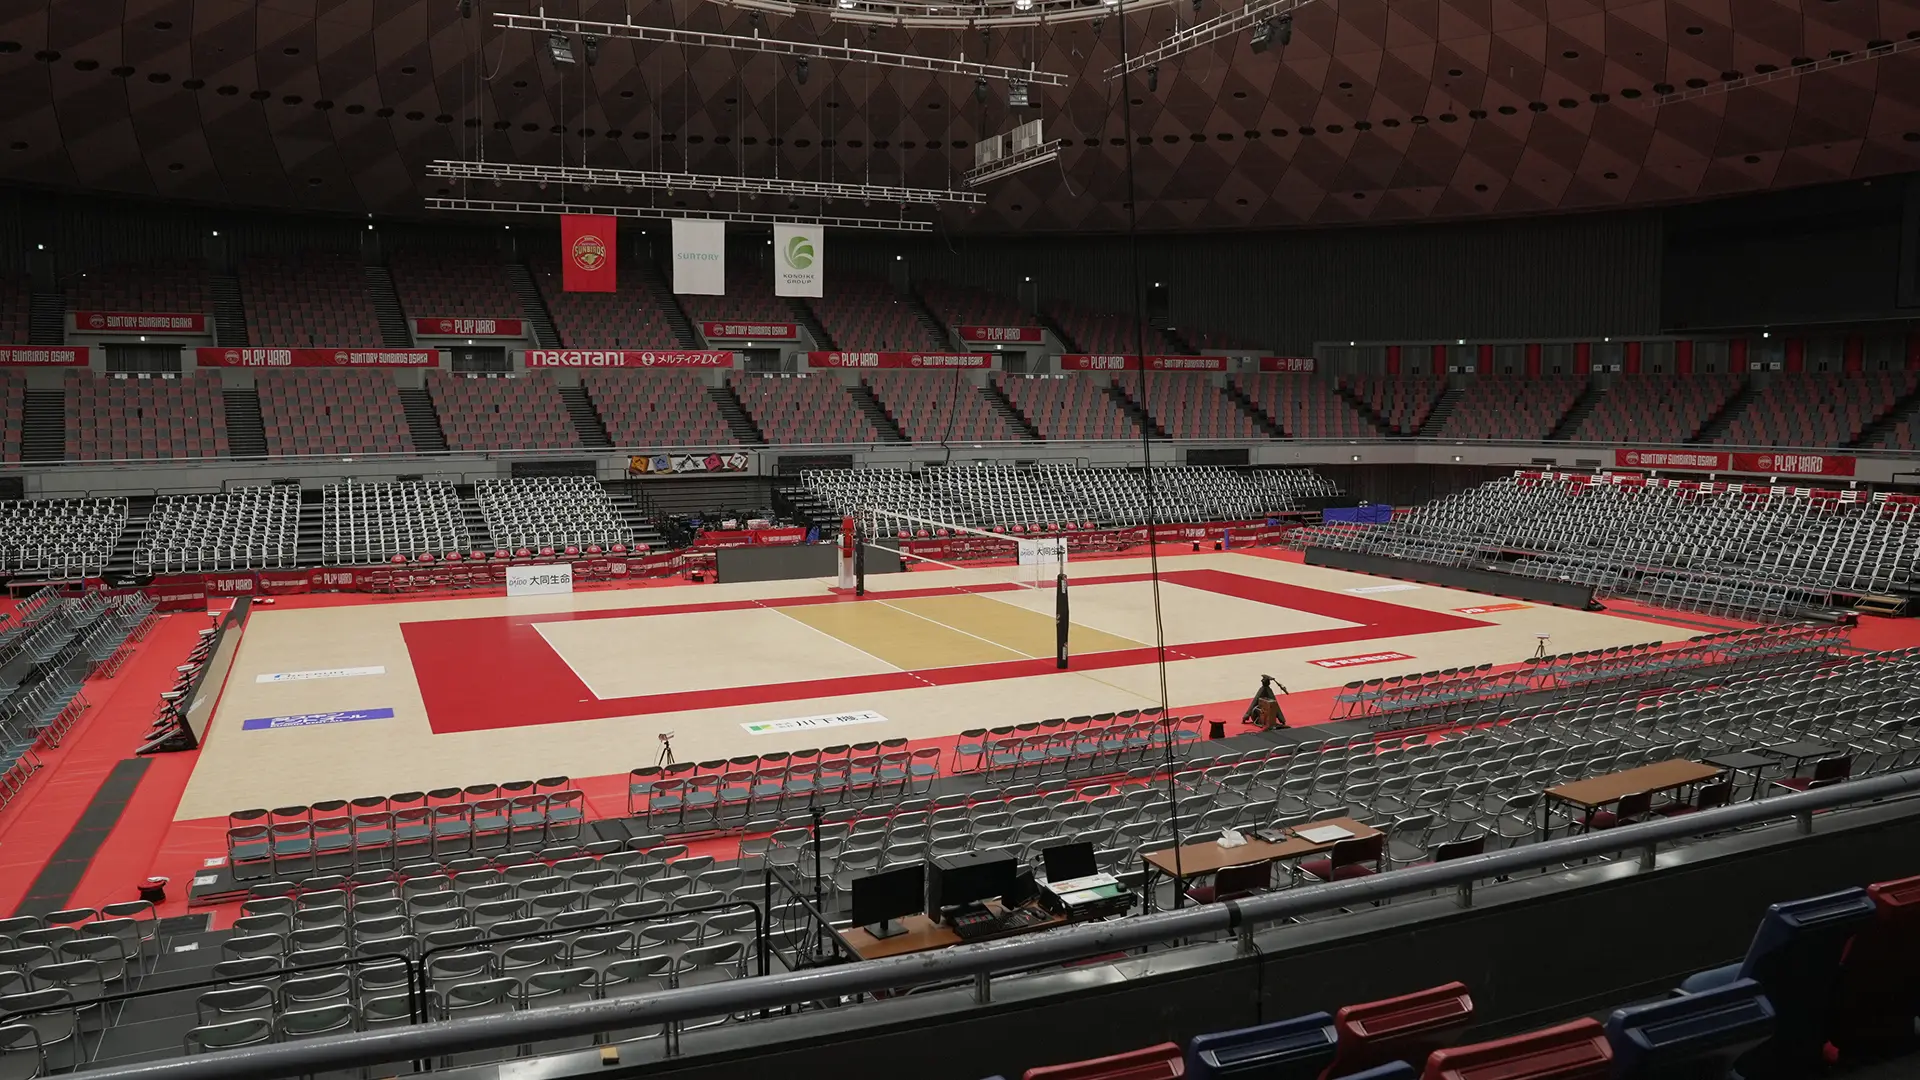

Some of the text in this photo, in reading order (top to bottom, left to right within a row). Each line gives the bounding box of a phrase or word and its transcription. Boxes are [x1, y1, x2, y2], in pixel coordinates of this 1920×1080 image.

[575, 245, 605, 257] SUNBIRDS
[677, 252, 719, 261] SUNTORY
[107, 316, 193, 328] SUNTORY SUNBIRDS OSAKA
[455, 319, 496, 333] PLAY HARD
[987, 328, 1021, 341] PLAY HARD
[12, 351, 49, 362] SUNBIRDS
[51, 351, 75, 362] OSAKA
[242, 349, 292, 366] PLAY HARD
[350, 352, 428, 364] SUNTORY SUNBIRDS OSAKA
[841, 353, 879, 366] PLAY HARD
[1091, 356, 1125, 369] PLAY HARD
[1288, 359, 1302, 370] PLAY
[1640, 453, 1718, 467] SUNTORY SUNBIRDS OSAKA
[1774, 455, 1824, 473] PLAY HARD
[323, 573, 337, 584] PLAY
[529, 574, 570, 586] 大同生命
[217, 579, 253, 591] PLAY HARD
